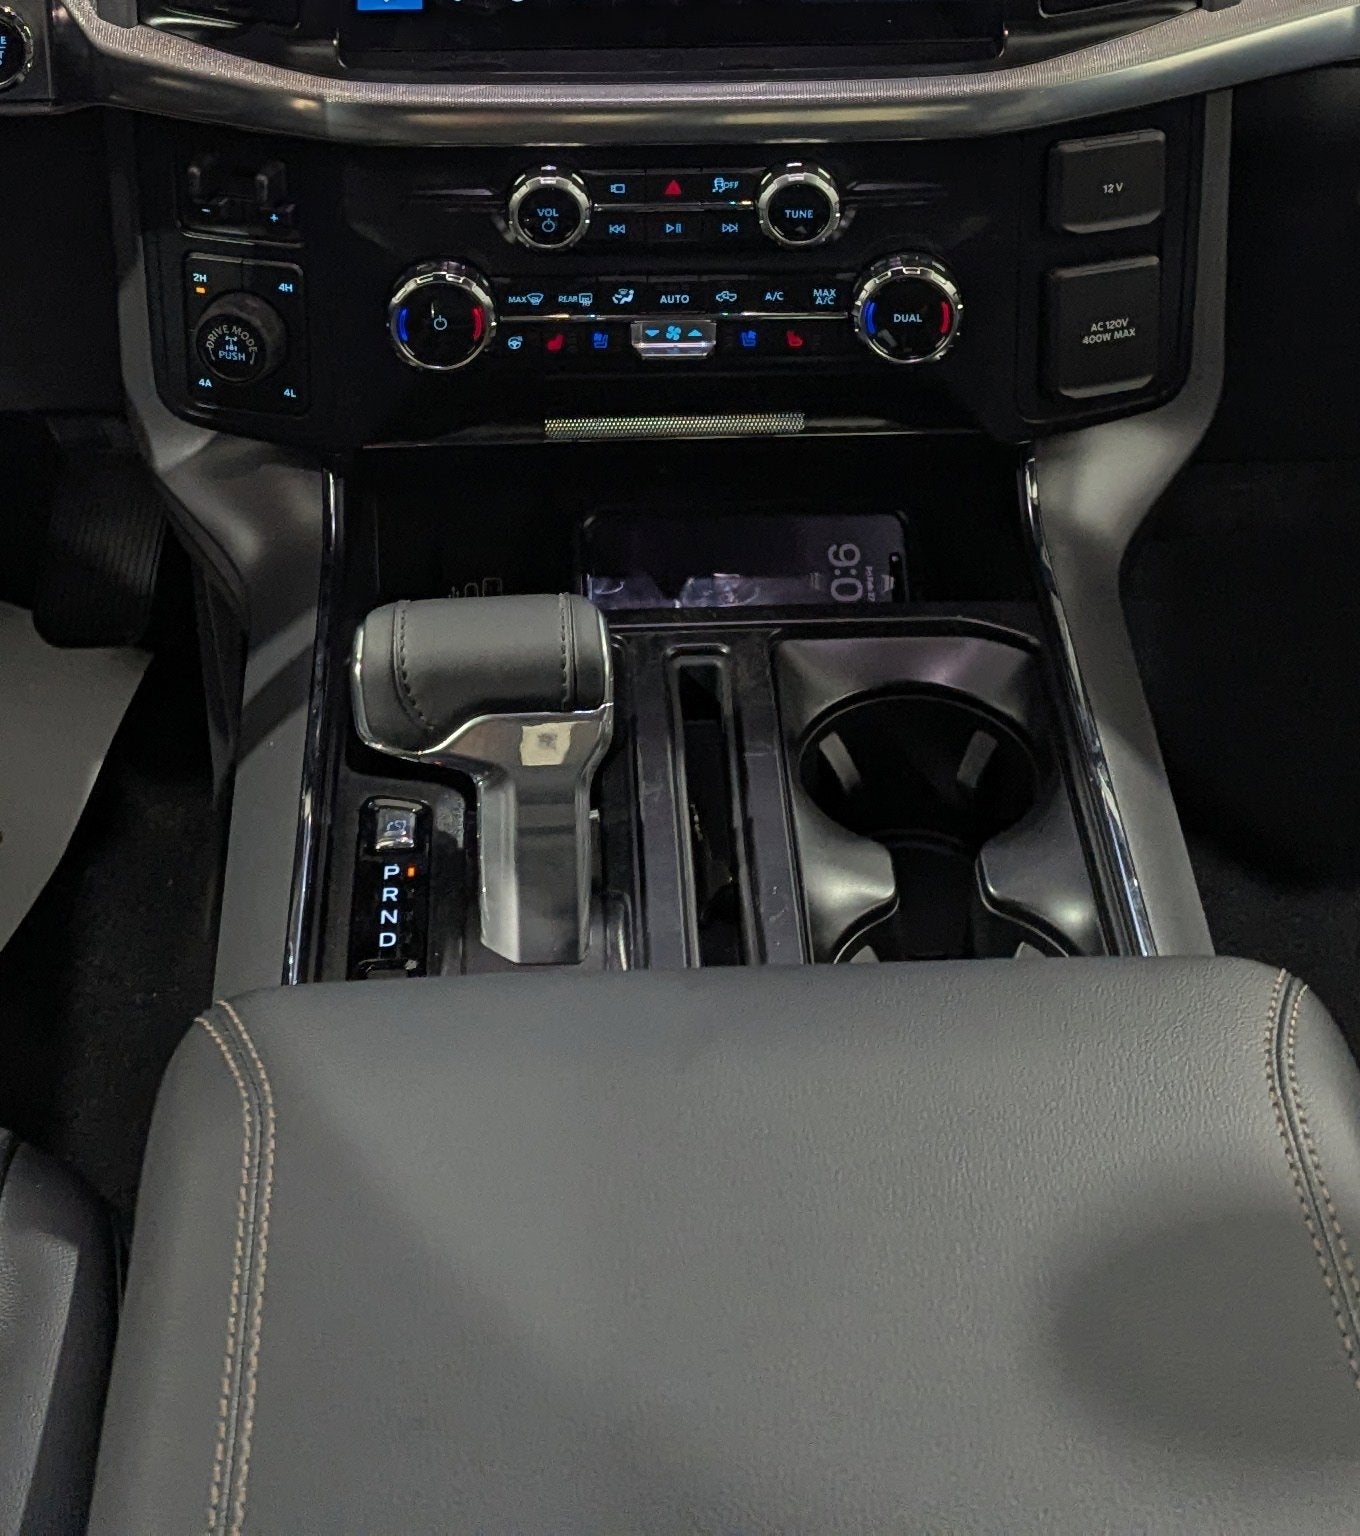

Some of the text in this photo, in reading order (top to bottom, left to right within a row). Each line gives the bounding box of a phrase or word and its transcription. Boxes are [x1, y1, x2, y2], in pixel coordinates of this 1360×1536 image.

[536, 208, 559, 218] VOL
[784, 210, 813, 219] TUNE
[193, 273, 207, 283] 2H
[278, 283, 293, 293] 4H
[813, 288, 836, 298] MAX
[508, 295, 527, 304] MAX
[659, 295, 690, 304] AUTO
[765, 291, 784, 301] A/C
[815, 296, 834, 305] A/C
[893, 313, 922, 323] DUAL
[1091, 318, 1129, 332] AC 120V
[206, 324, 258, 353] DRIVE MODE
[1082, 328, 1136, 344] 400W MAX
[218, 351, 245, 361] PUSH
[198, 378, 212, 388] 4A
[283, 388, 297, 398] 4L
[827, 544, 863, 602] 9:0
[383, 865, 400, 880] P
[382, 887, 399, 902] R
[380, 909, 398, 924] N
[379, 932, 396, 947] D
